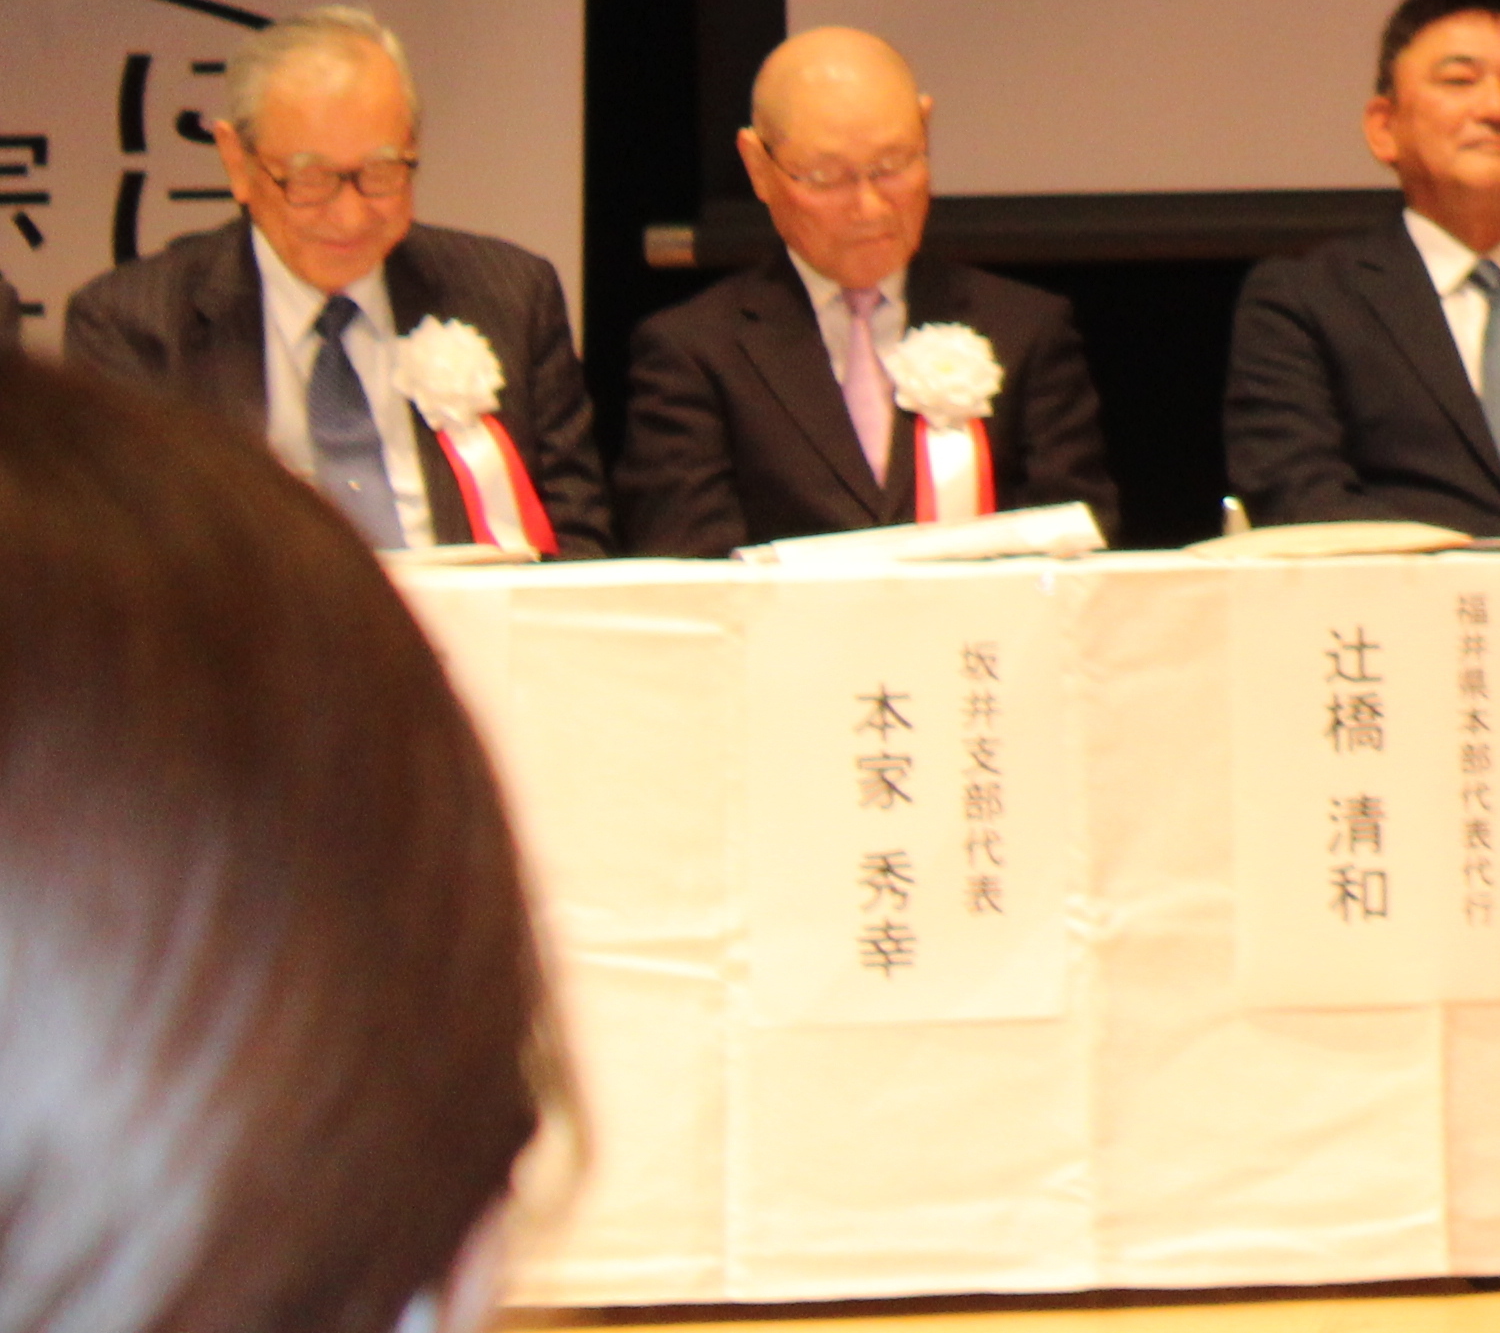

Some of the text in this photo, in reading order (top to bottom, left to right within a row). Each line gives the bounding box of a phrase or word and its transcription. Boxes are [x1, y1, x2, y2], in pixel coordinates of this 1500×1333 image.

[855, 683, 918, 979] 本家 秀幸
[1325, 625, 1389, 923] 辻橋 清和
